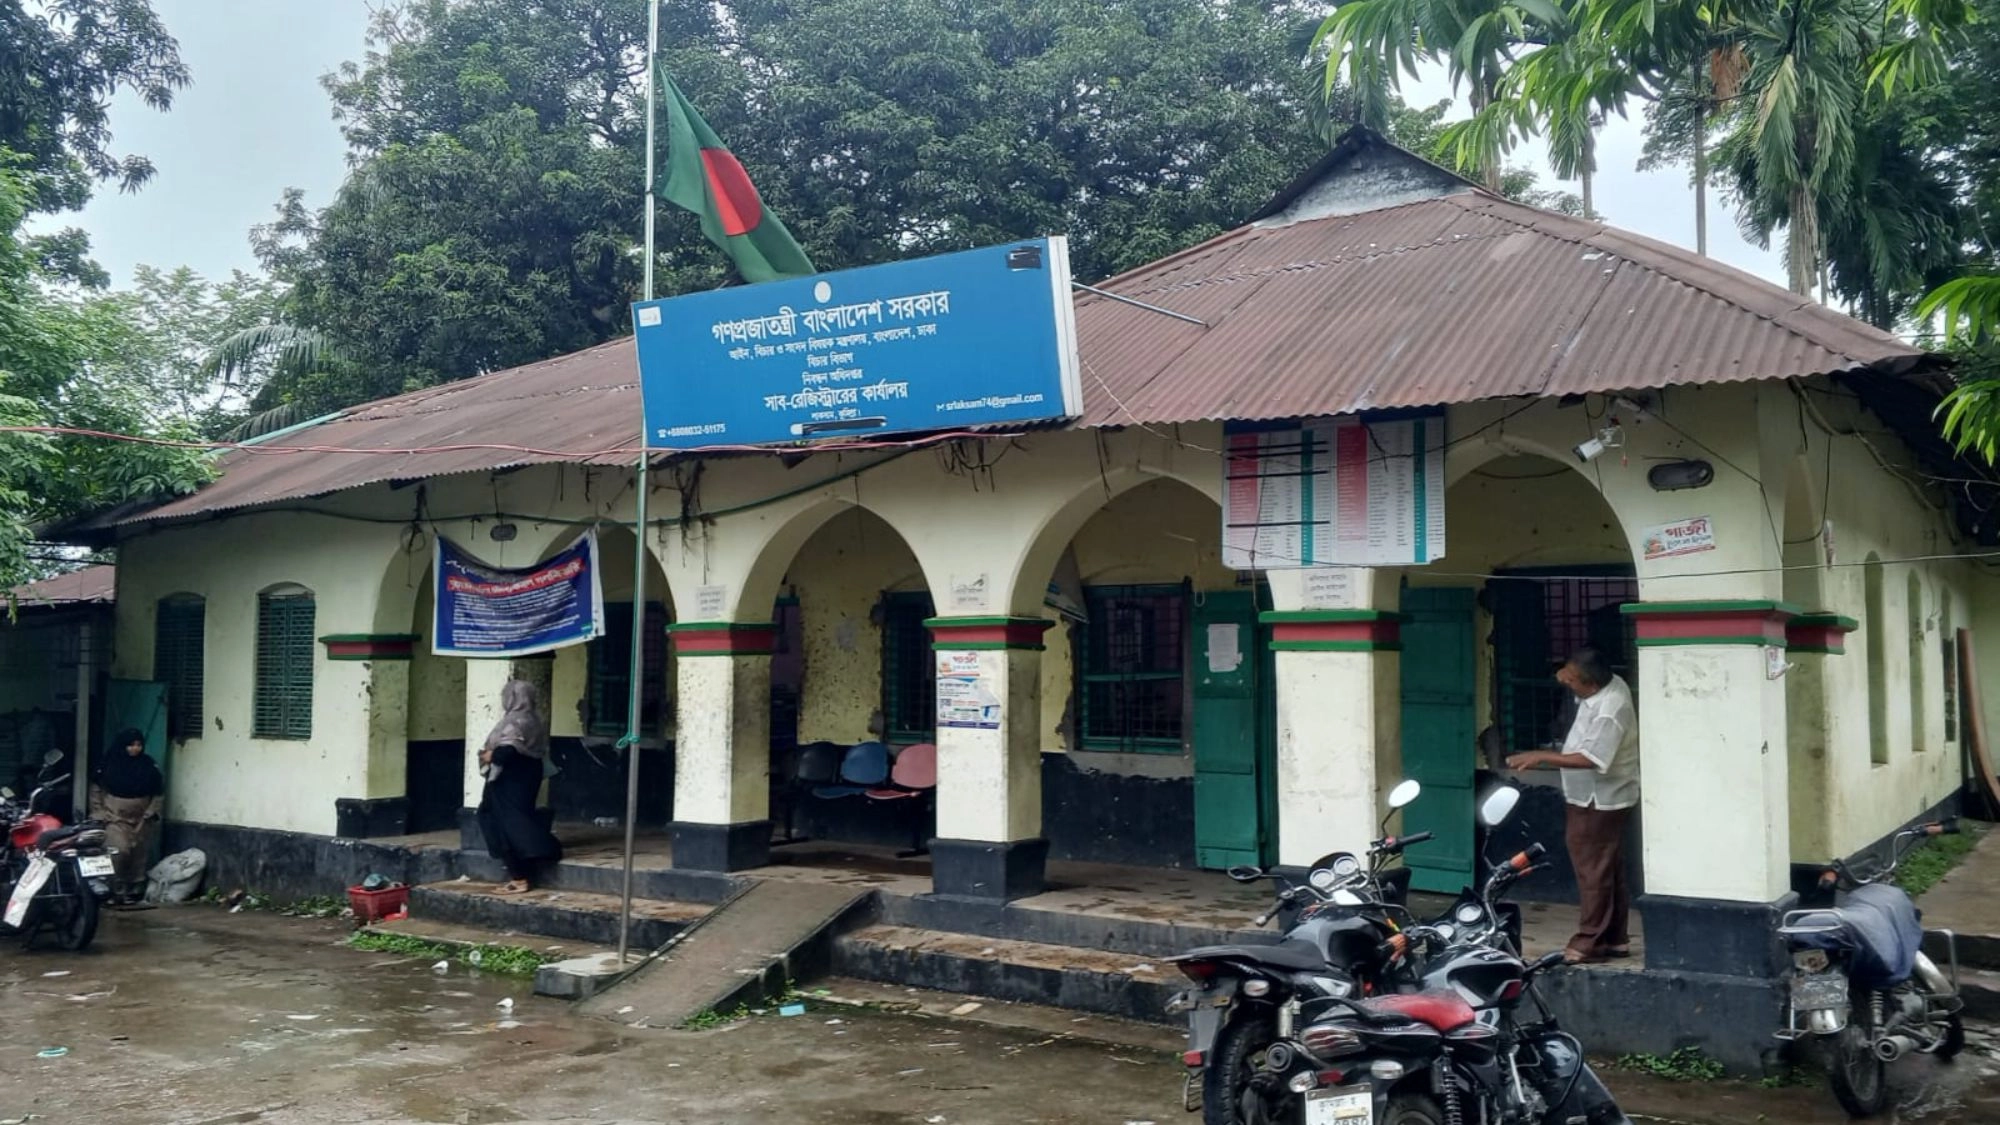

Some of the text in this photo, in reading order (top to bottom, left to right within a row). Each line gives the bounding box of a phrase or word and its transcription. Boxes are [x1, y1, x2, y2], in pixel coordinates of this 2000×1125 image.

[711, 291, 950, 345] গণপ্রজাতন্ত্রী বাংলাদেশ সরকার
[776, 345, 784, 354] ও
[860, 378, 909, 401] কার্যালয়
